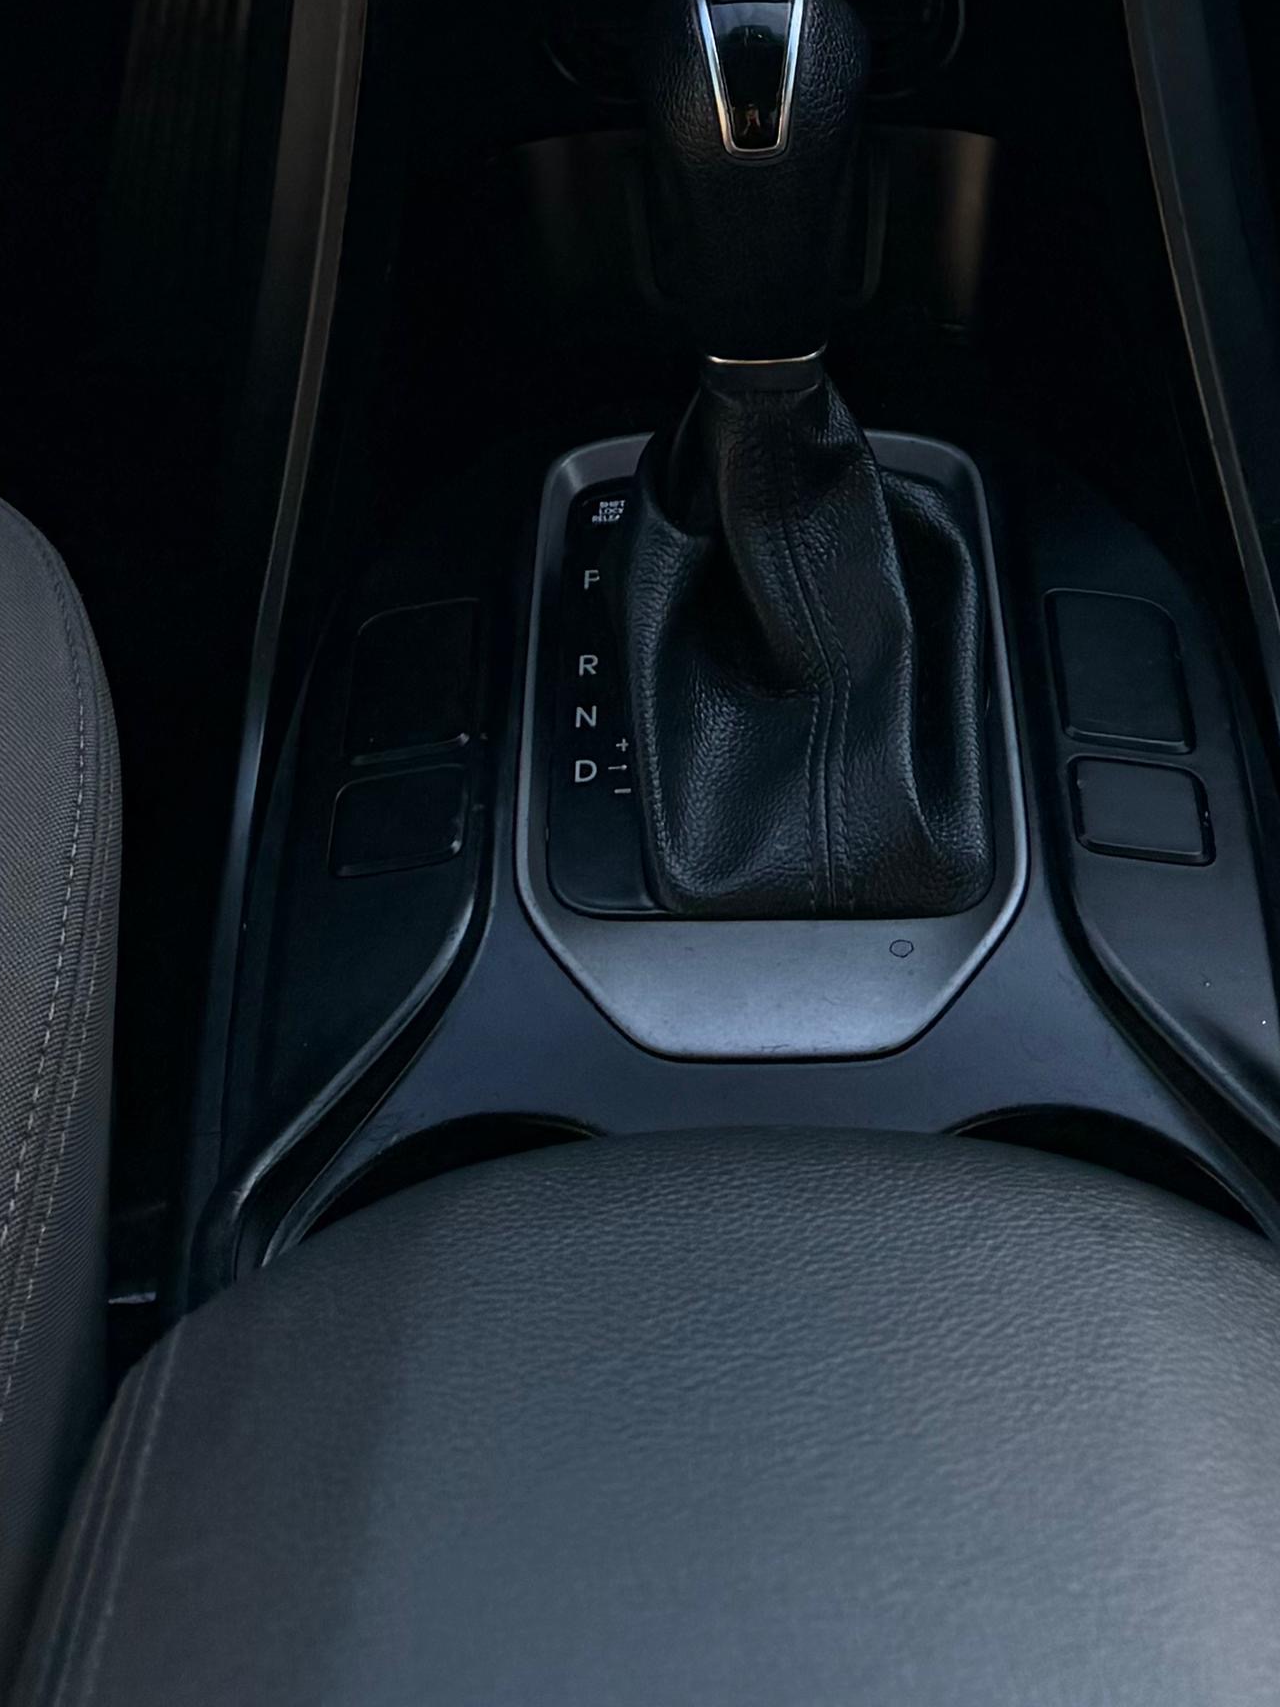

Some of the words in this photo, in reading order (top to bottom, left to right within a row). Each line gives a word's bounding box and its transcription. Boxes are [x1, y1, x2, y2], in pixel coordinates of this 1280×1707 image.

[578, 654, 599, 676] R
[575, 705, 597, 728] N
[574, 759, 598, 783] D
